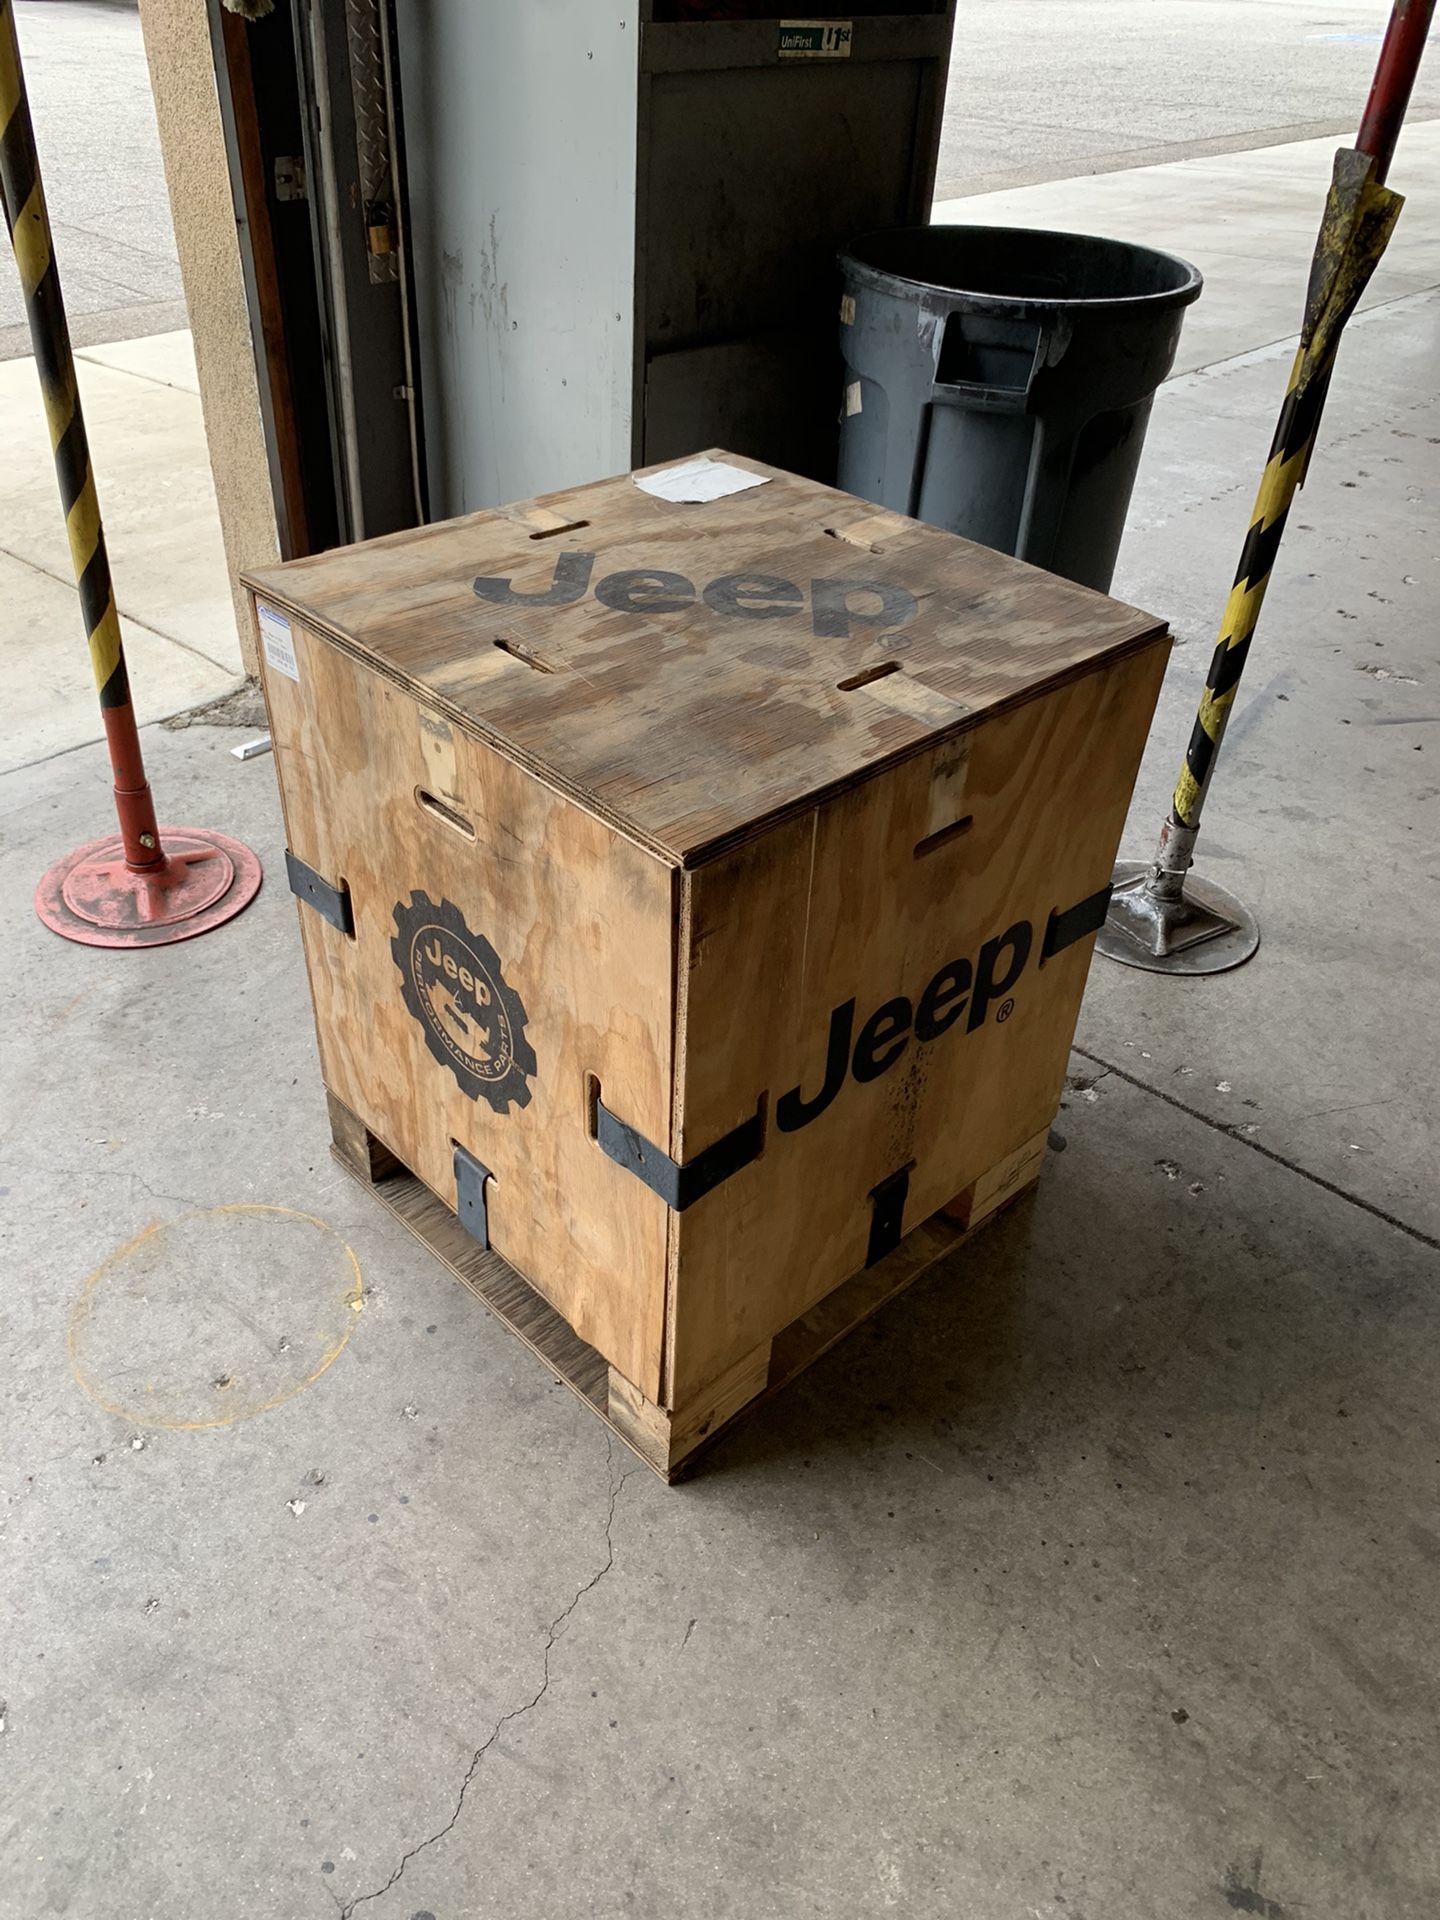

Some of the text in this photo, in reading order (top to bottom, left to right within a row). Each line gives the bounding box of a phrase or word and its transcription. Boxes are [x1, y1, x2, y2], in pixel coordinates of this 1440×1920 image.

[781, 35, 813, 49] UniFirst
[472, 551, 919, 639] Jeep
[414, 948, 511, 1076] PERFORMANCE PARTS
[424, 938, 493, 1008] Jeep
[775, 919, 1034, 1134] Jeep
